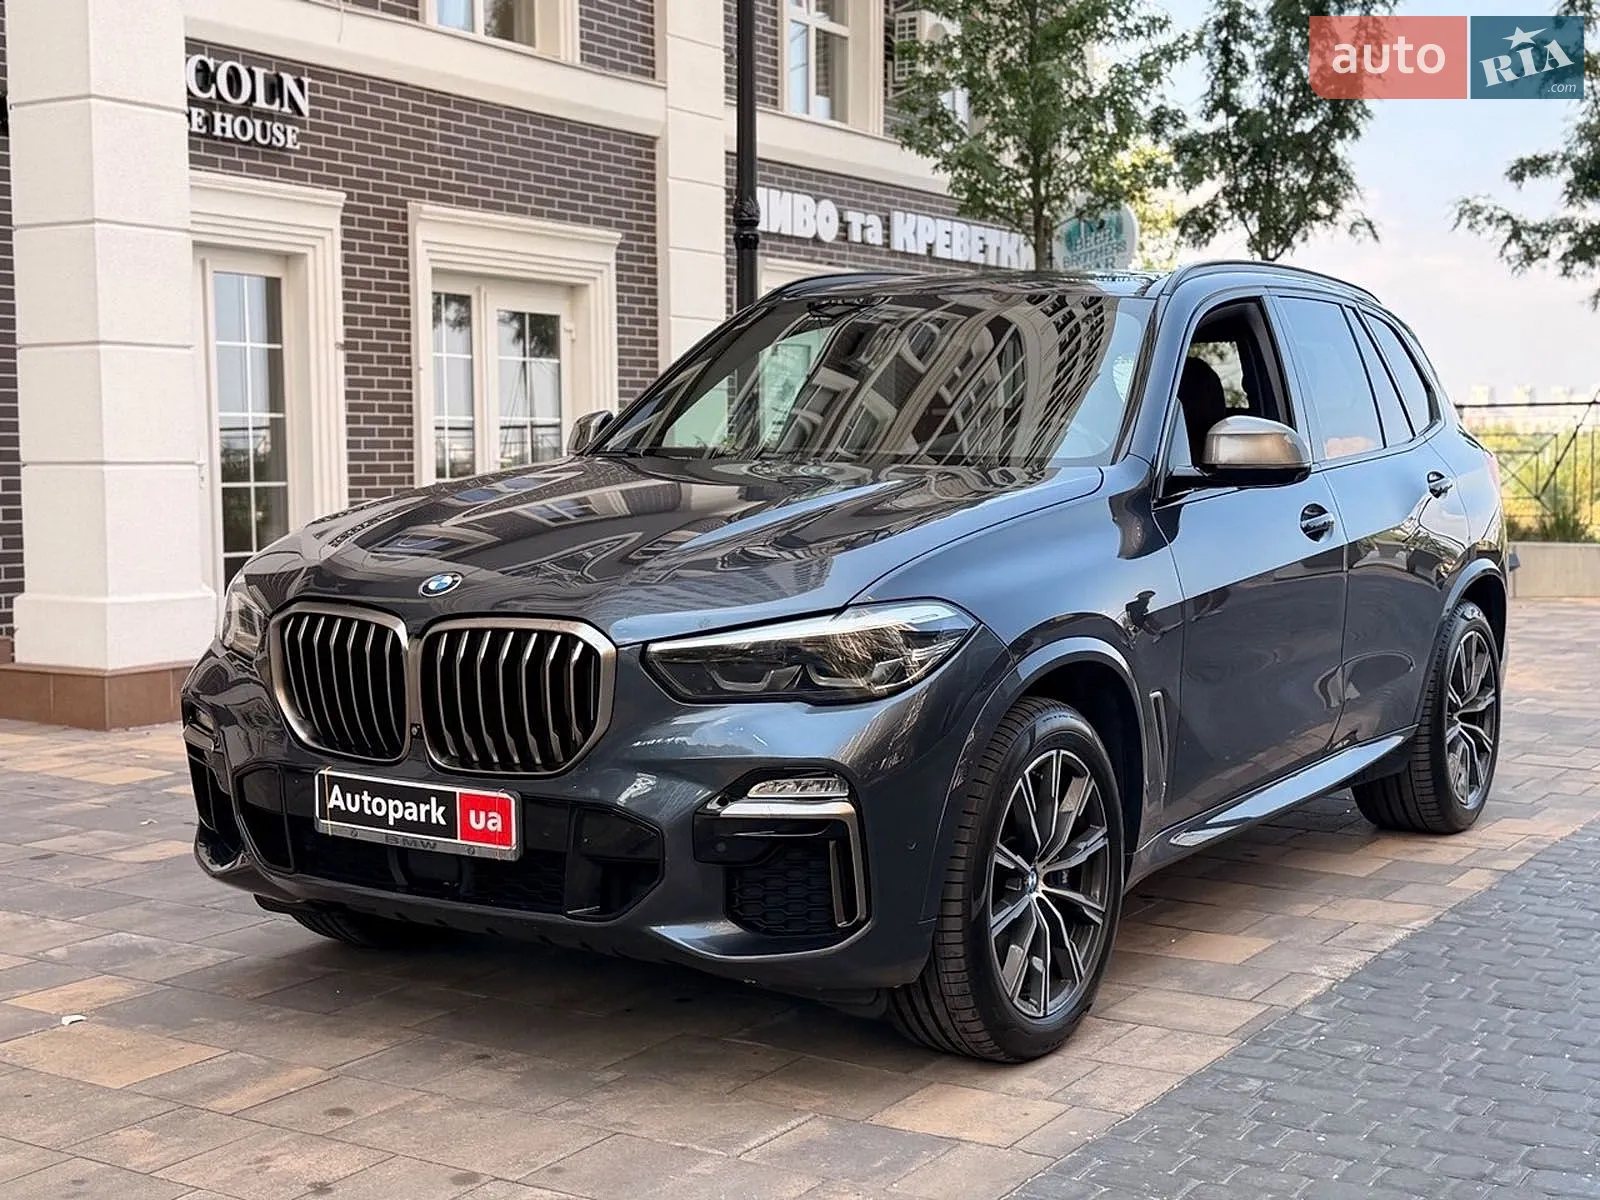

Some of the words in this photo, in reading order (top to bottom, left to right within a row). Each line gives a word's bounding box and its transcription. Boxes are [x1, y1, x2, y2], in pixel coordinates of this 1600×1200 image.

[212, 111, 301, 150] HOUSE
[843, 210, 883, 246] та
[328, 784, 447, 825] Autopark
[469, 809, 503, 832] ua
[384, 833, 438, 850] BMW
